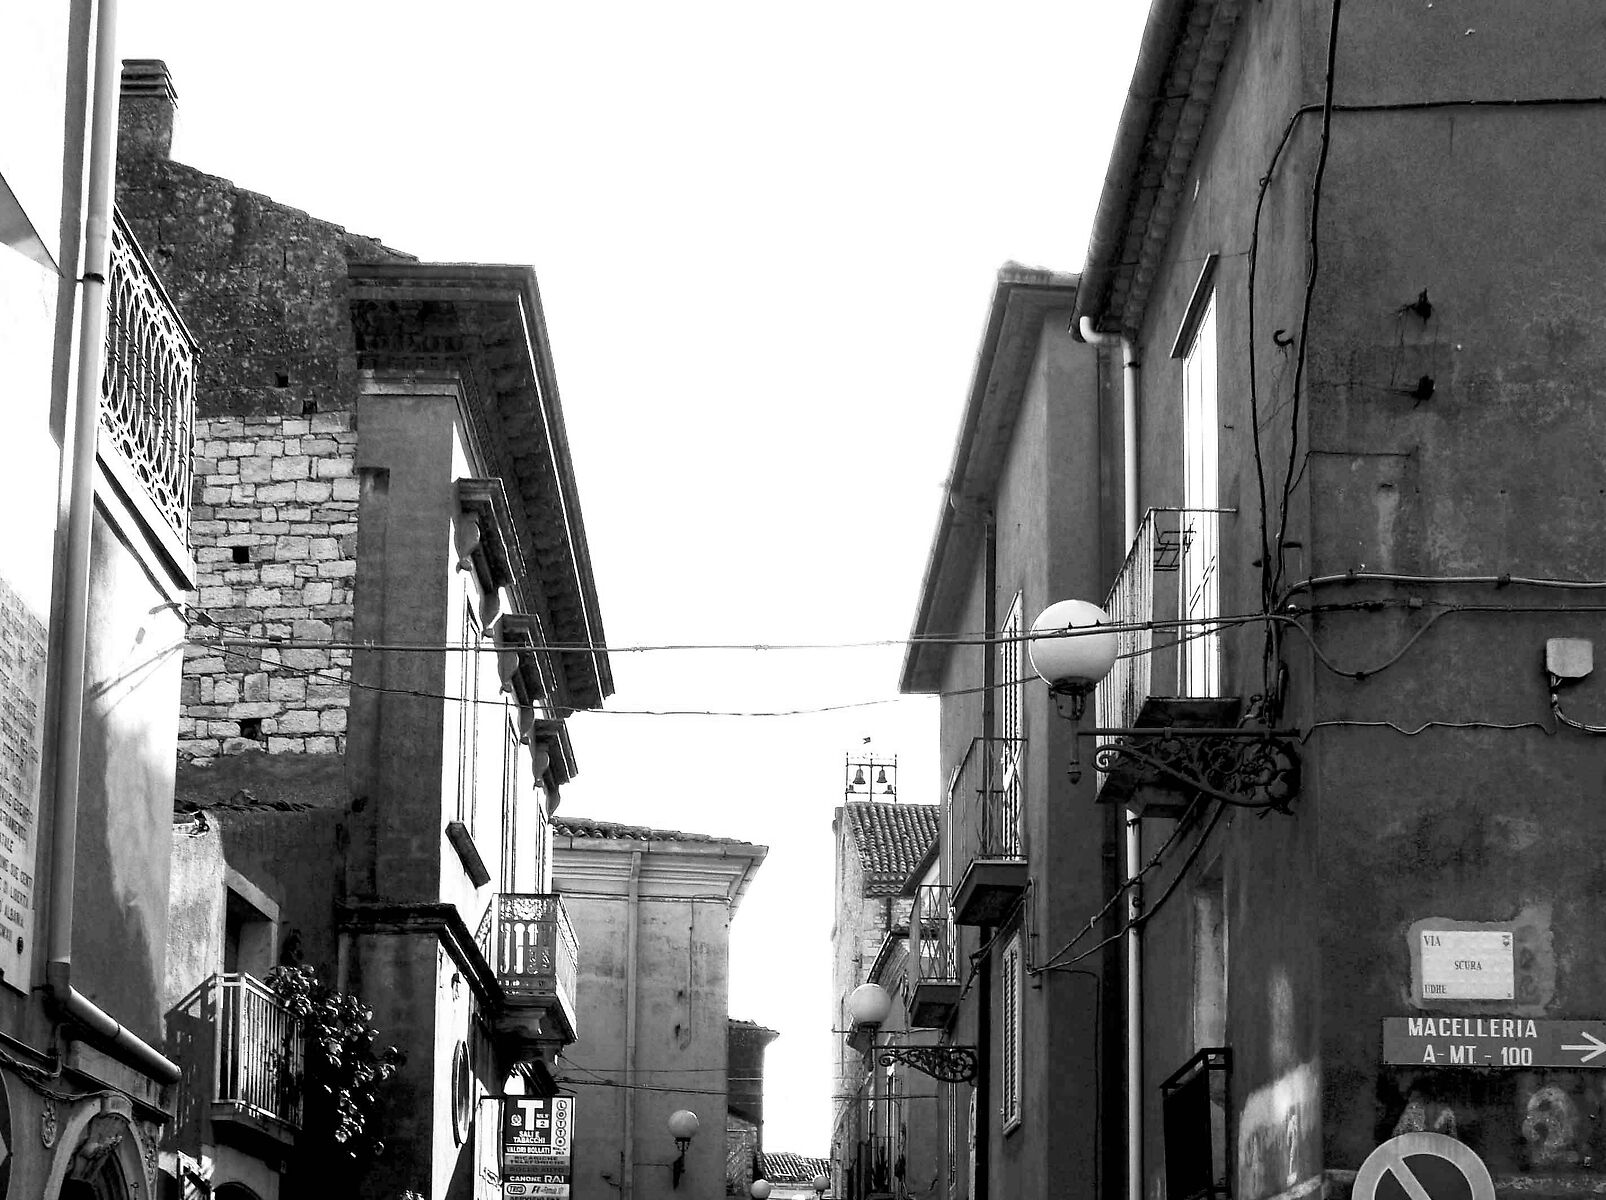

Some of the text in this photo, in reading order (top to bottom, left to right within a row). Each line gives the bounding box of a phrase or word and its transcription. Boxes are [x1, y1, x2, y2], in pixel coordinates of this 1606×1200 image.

[1424, 935, 1441, 947] VIA
[1454, 961, 1482, 971] SCURA
[1408, 1018, 1537, 1038] MACELLERIA
[1501, 1047, 1533, 1066] 100
[517, 1099, 544, 1131] T
[556, 1100, 567, 1146] LOTTO
[513, 1136, 546, 1144] TABACCHI
[527, 1146, 550, 1154] BOLLATI
[544, 1175, 564, 1183] RAI
